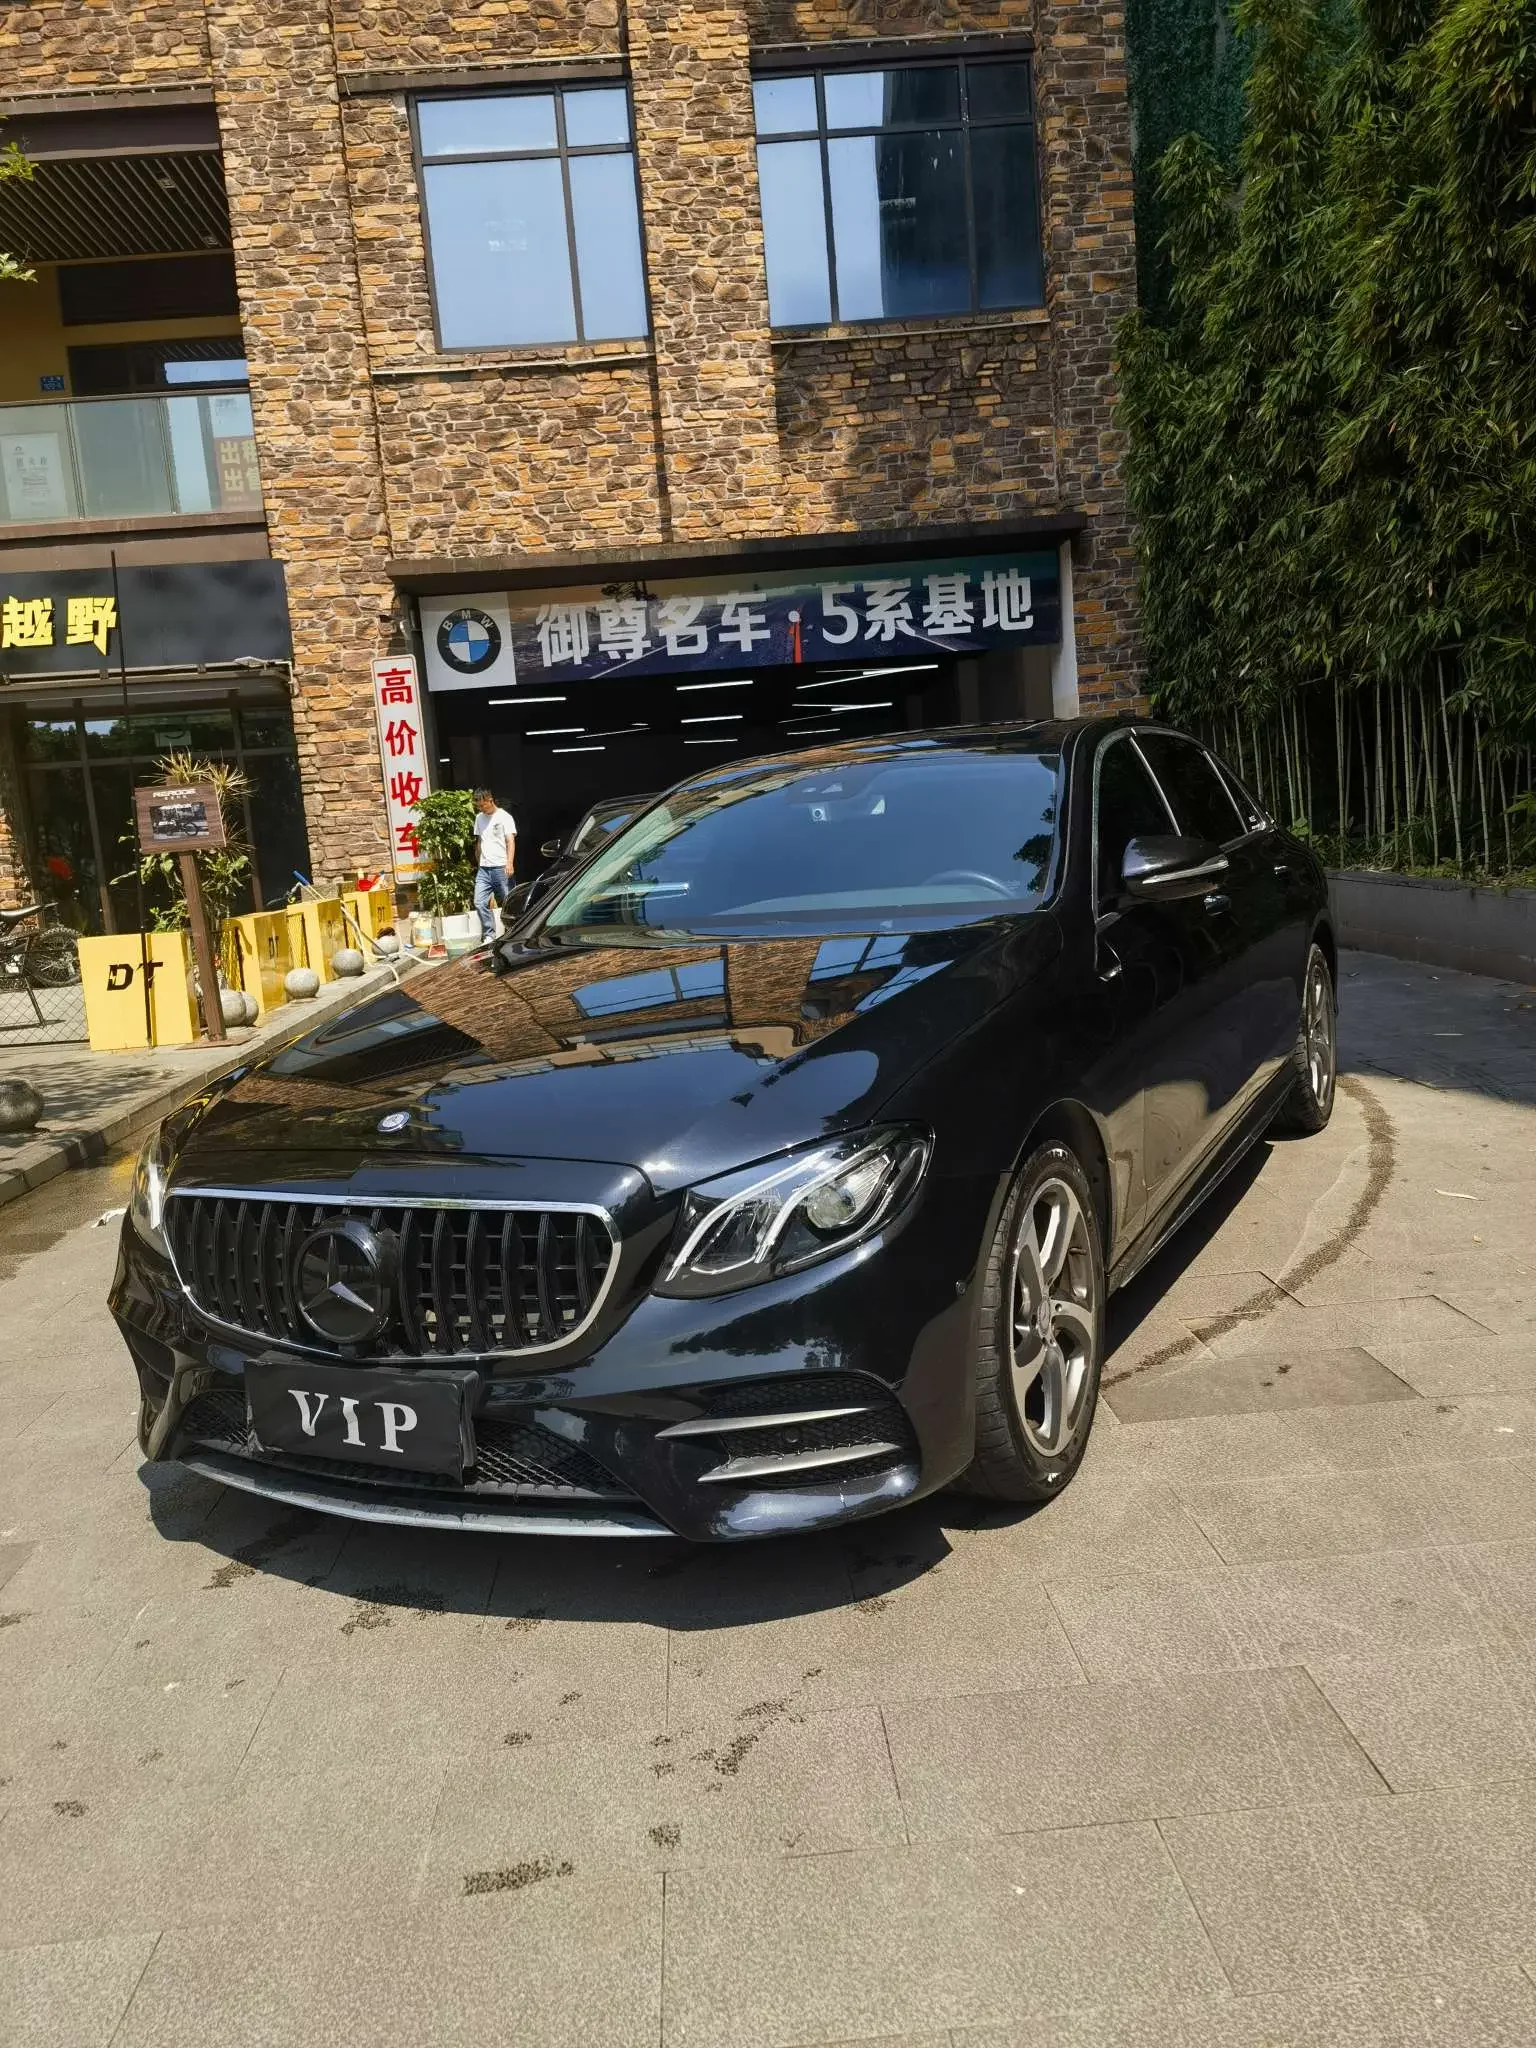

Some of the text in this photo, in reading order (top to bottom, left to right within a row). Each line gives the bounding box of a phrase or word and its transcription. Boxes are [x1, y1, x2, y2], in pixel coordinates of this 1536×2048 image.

[2, 595, 117, 656] 越野
[442, 610, 494, 631] BMW
[377, 668, 423, 858] 高价收车
[107, 961, 163, 991] DT
[288, 1389, 418, 1453] VIP
